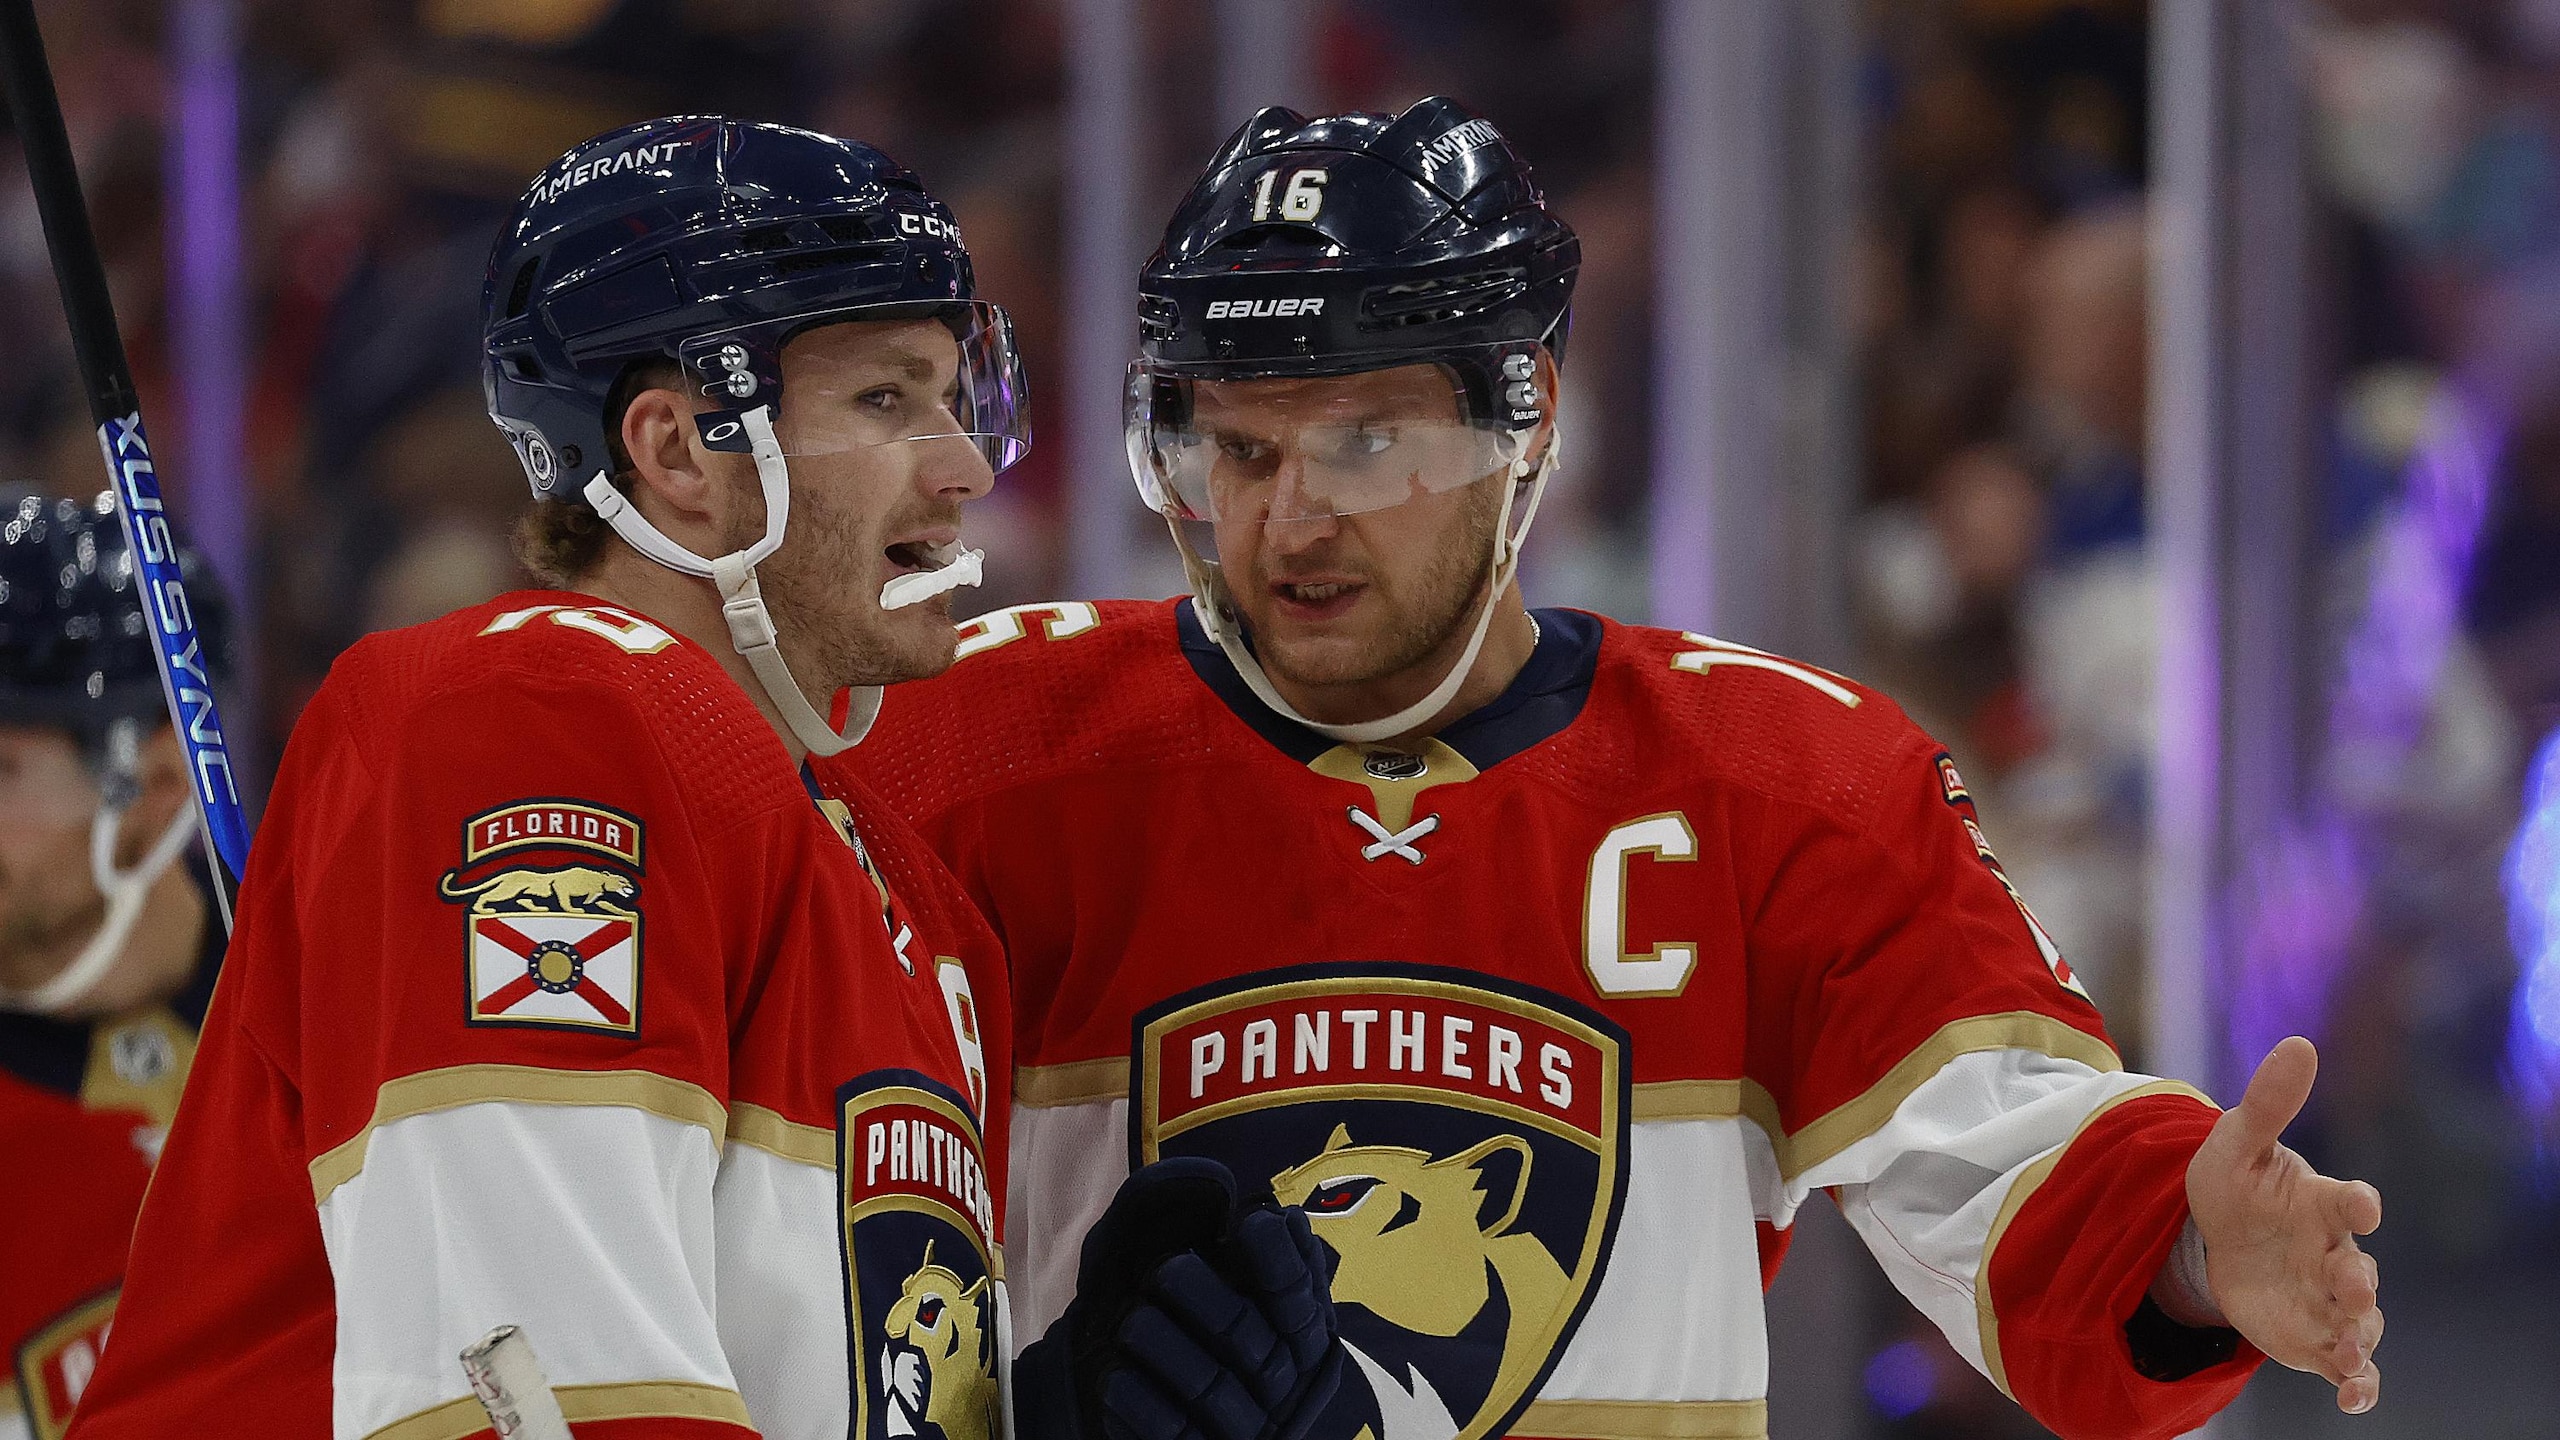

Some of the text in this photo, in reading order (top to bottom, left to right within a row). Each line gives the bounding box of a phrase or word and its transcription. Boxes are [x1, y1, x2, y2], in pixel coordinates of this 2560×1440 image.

[529, 142, 682, 208] AMERANT
[1252, 168, 1329, 222] 16
[152, 578, 239, 806] SYNC
[486, 812, 622, 848] FLORIDA
[1581, 811, 1698, 1000] C
[1190, 1009, 1574, 1110] PANTHERS
